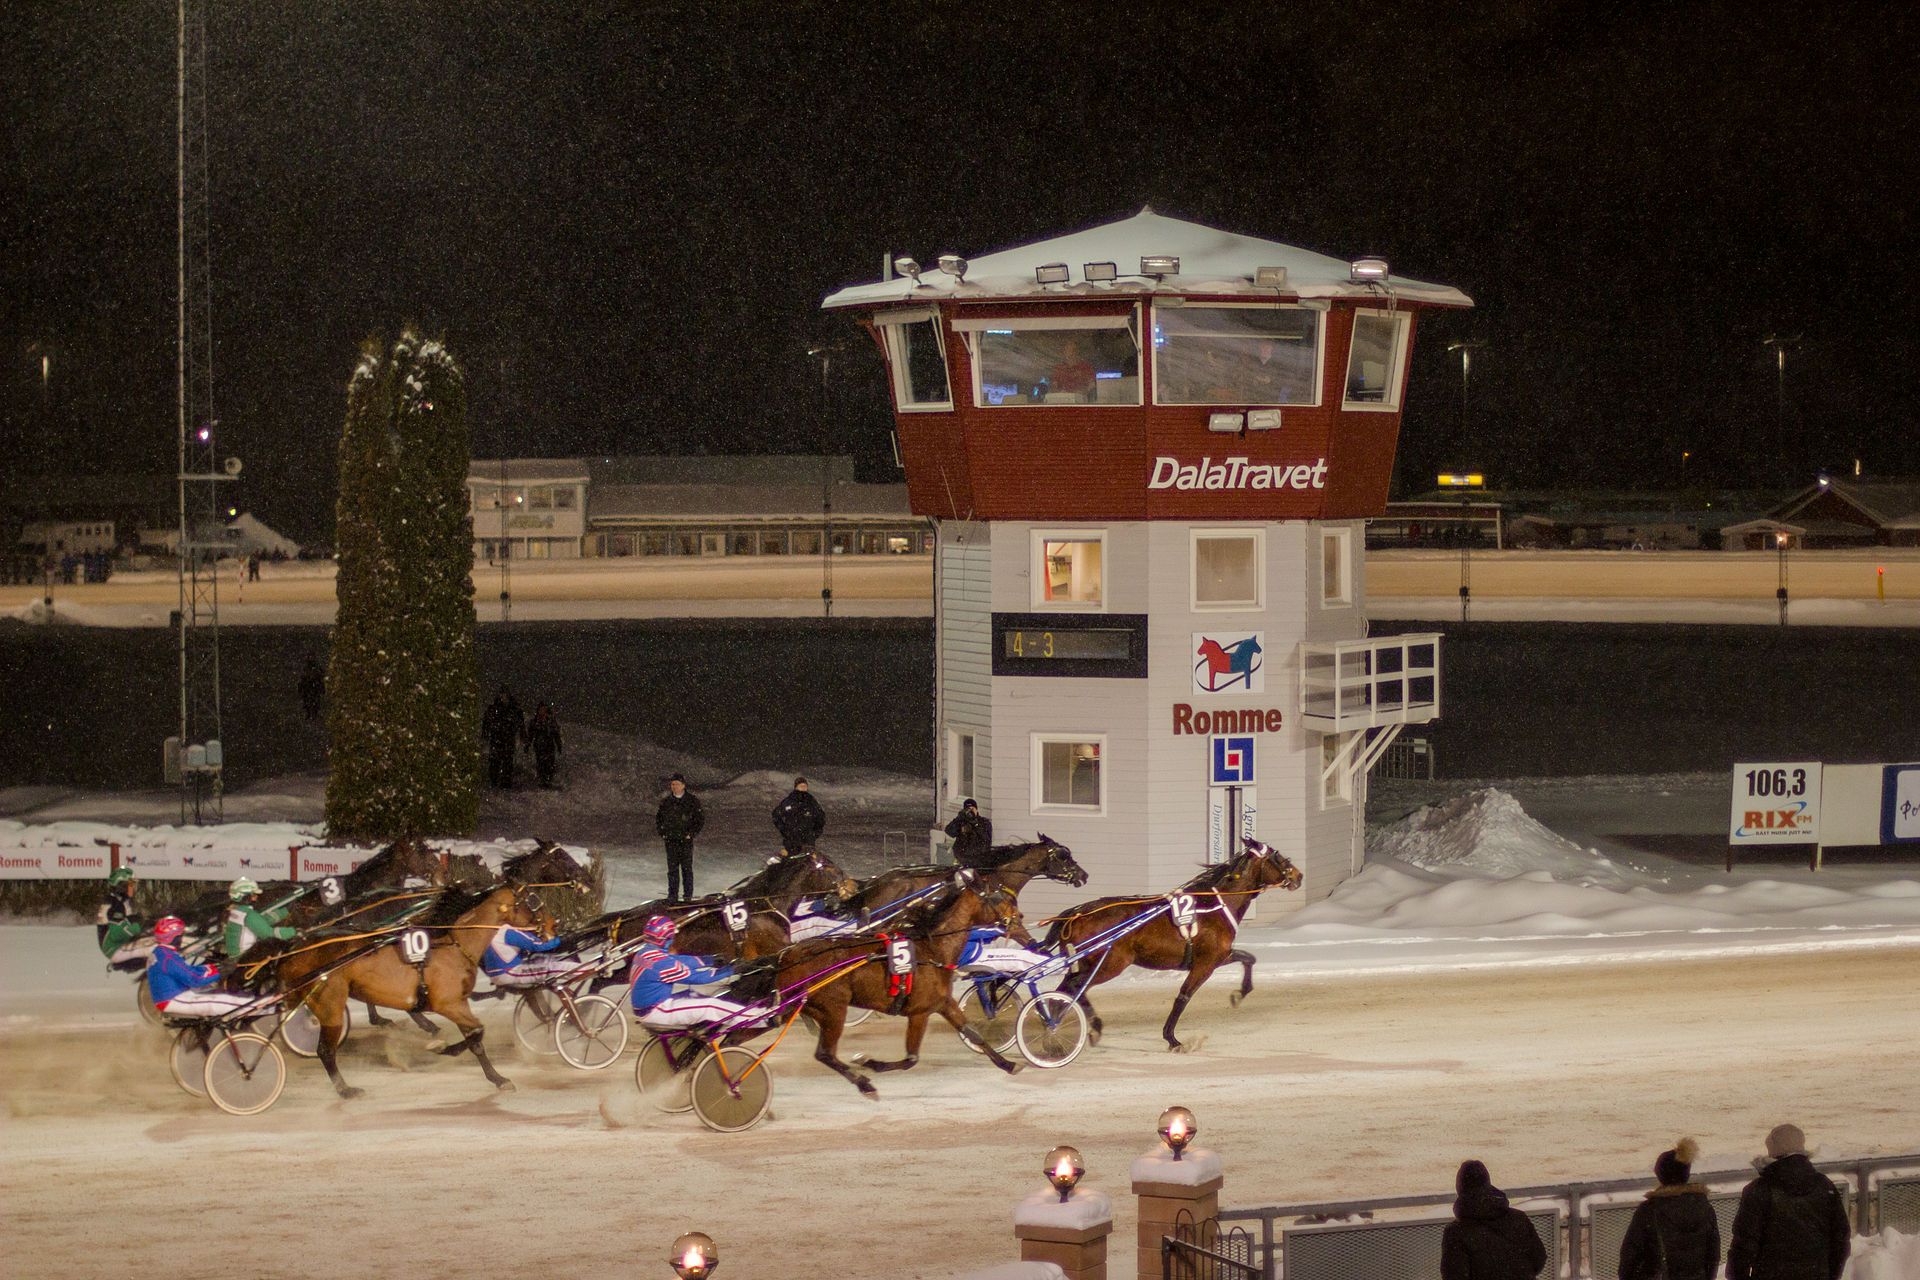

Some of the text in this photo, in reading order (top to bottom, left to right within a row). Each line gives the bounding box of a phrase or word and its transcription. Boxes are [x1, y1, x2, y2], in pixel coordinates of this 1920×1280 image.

[1148, 456, 1328, 490] DalaTravet
[1173, 703, 1282, 735] Romme
[1746, 769, 1806, 798] 106,3
[1744, 810, 1812, 828] RIX FM
[58, 855, 103, 867] Romme
[304, 859, 338, 873] Romme
[322, 878, 340, 899] 3
[724, 901, 748, 925] 15
[1170, 895, 1195, 917] 12
[402, 931, 429, 955] 10
[893, 941, 911, 966] 5
